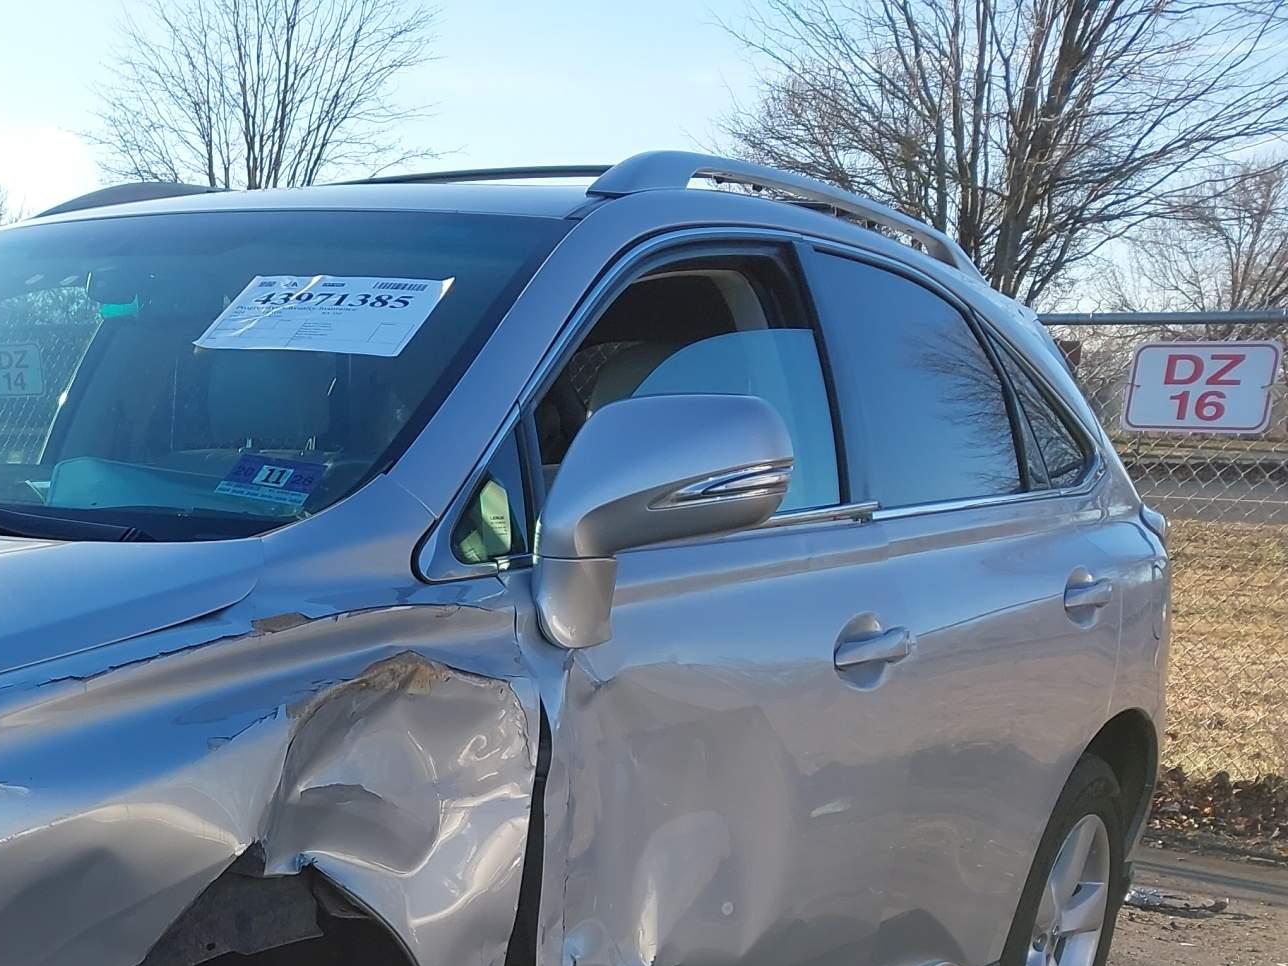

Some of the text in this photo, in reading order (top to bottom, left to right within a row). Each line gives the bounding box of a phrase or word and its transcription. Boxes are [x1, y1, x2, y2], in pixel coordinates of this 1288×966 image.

[254, 292, 414, 309] 43971385
[1164, 354, 1247, 385] DZ
[2, 371, 26, 391] 14
[1169, 390, 1227, 421] 16
[261, 468, 287, 485] 11
